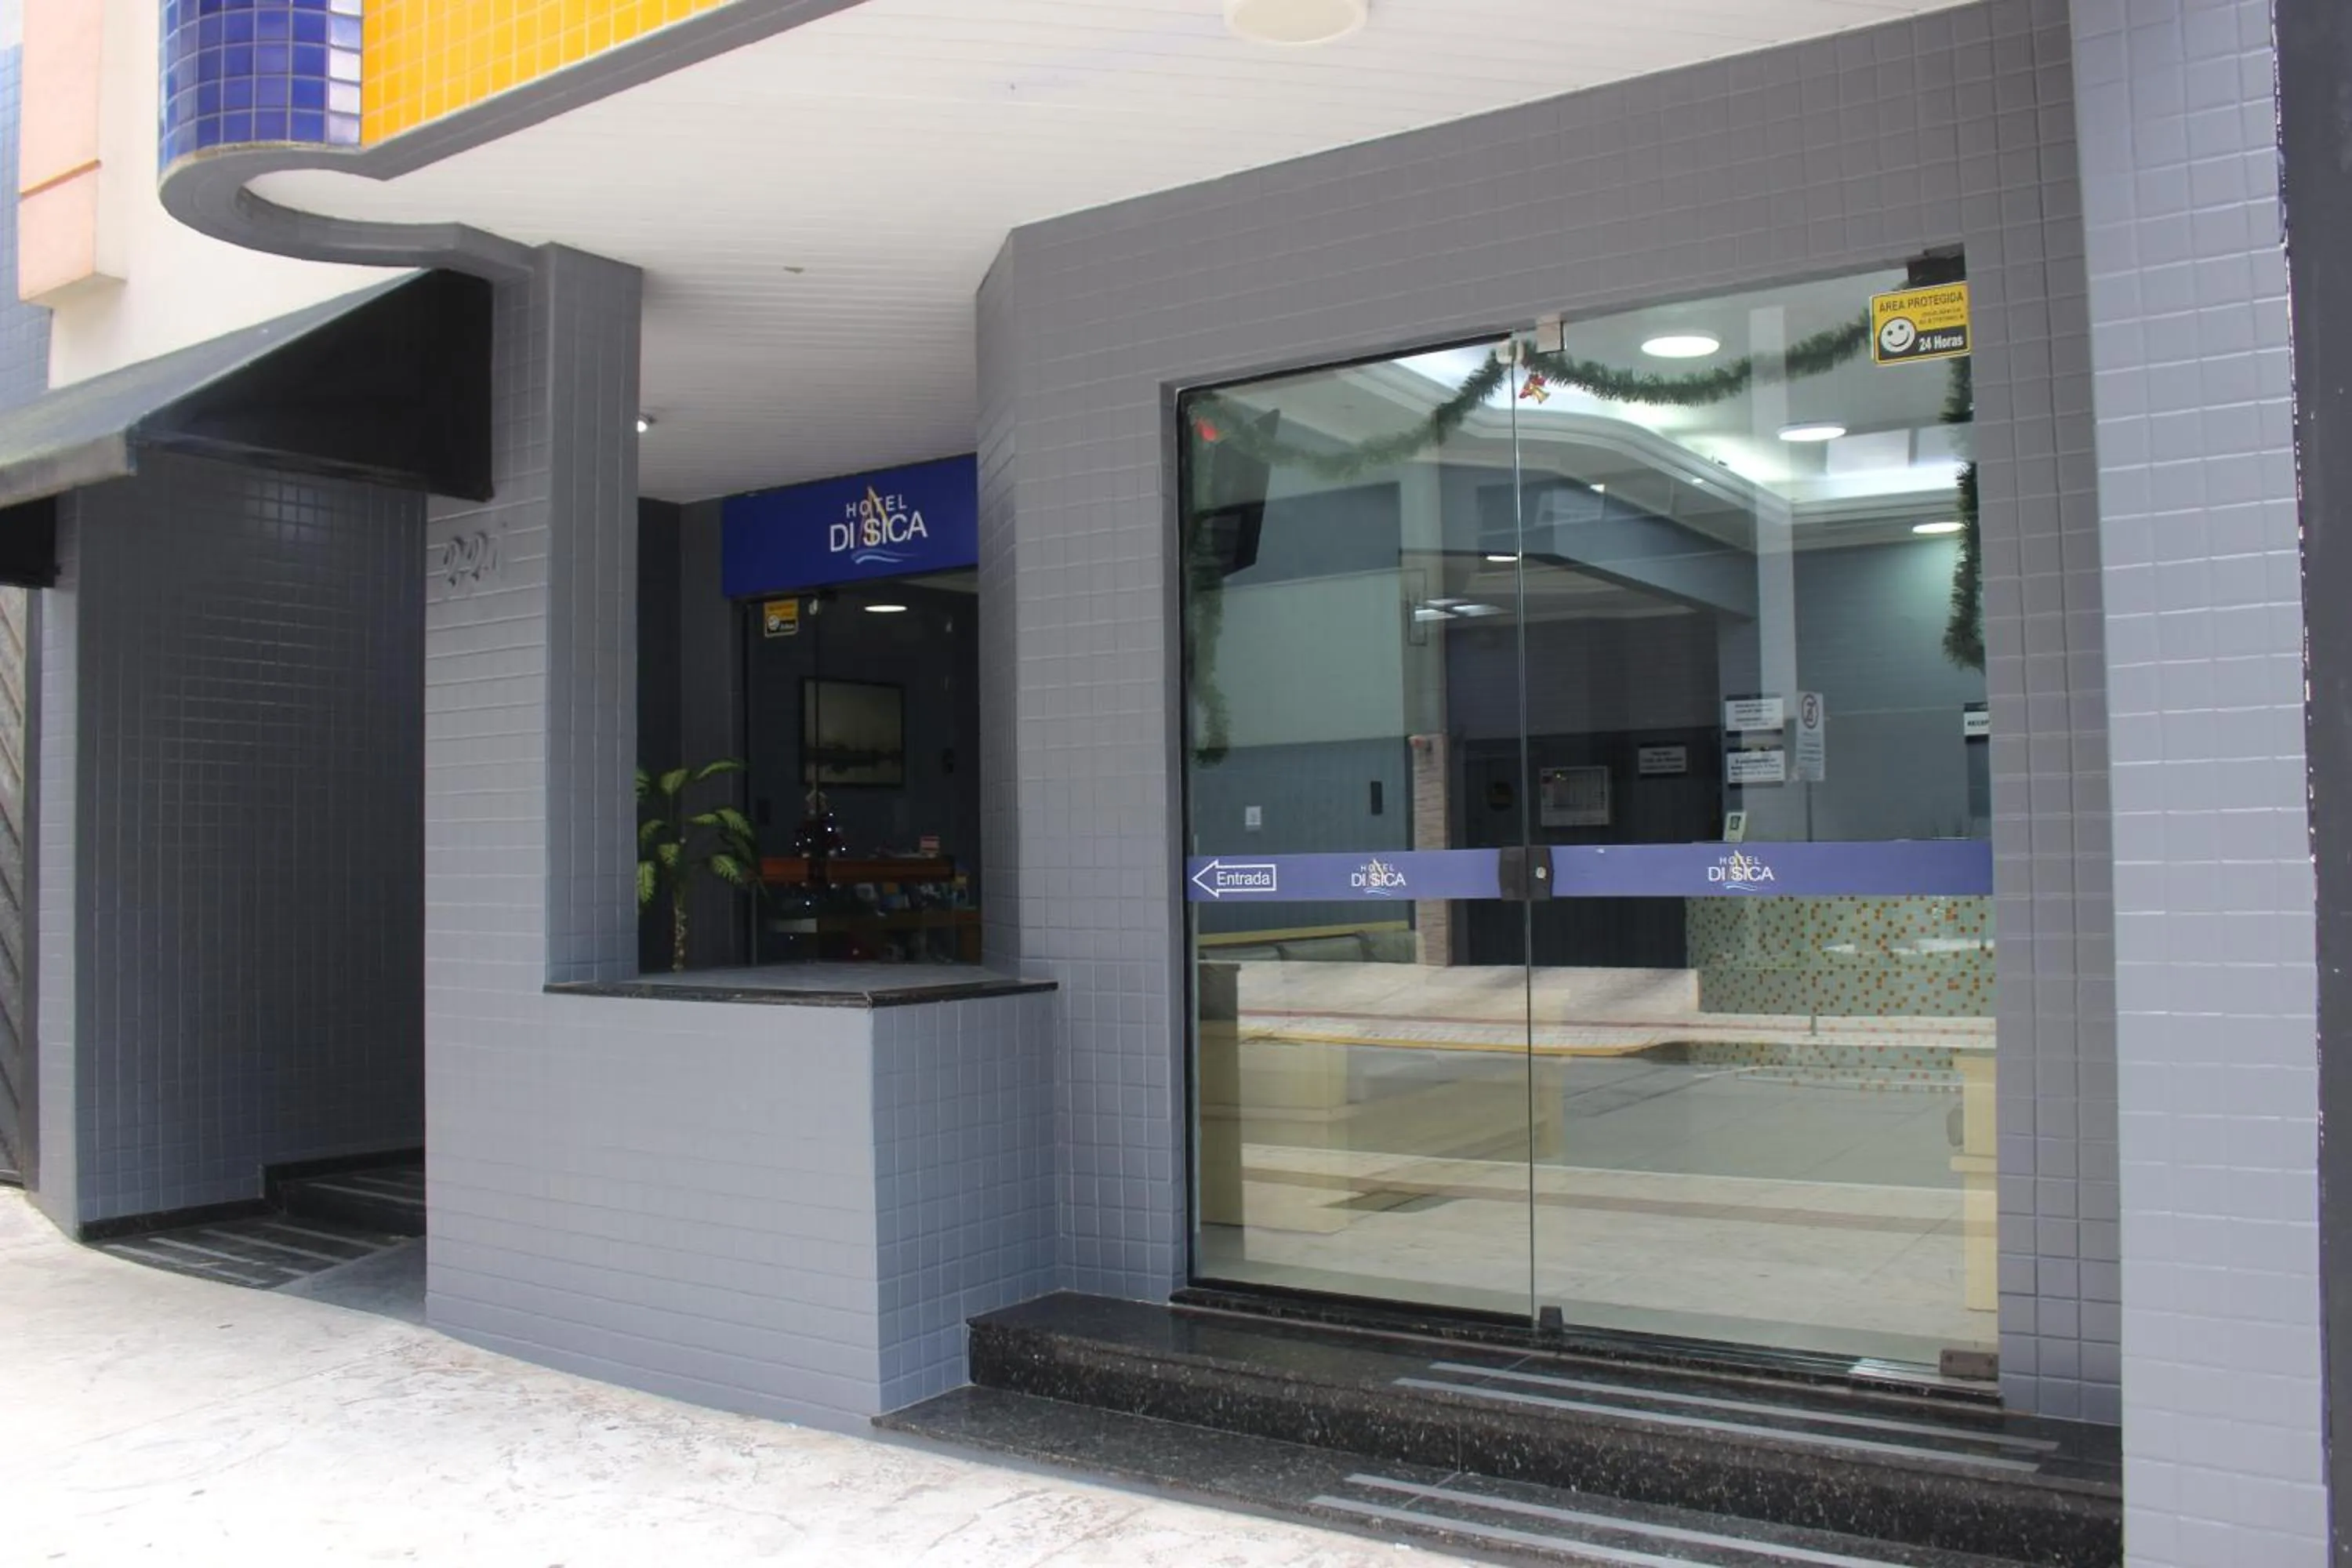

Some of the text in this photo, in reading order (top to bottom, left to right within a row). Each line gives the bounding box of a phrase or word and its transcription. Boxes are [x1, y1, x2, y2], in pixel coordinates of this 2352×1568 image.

[1907, 291, 1964, 308] PROTEGIDA
[1918, 335, 1964, 352] 24 Horas
[846, 494, 907, 519] HOTEL
[830, 511, 928, 552] DI SICA
[1360, 862, 1395, 873] HOTEL
[1719, 855, 1762, 866] HOTEL
[1217, 871, 1271, 886] Entrada
[1351, 872, 1406, 887] DI SICA
[1708, 866, 1775, 882] DI SICA
